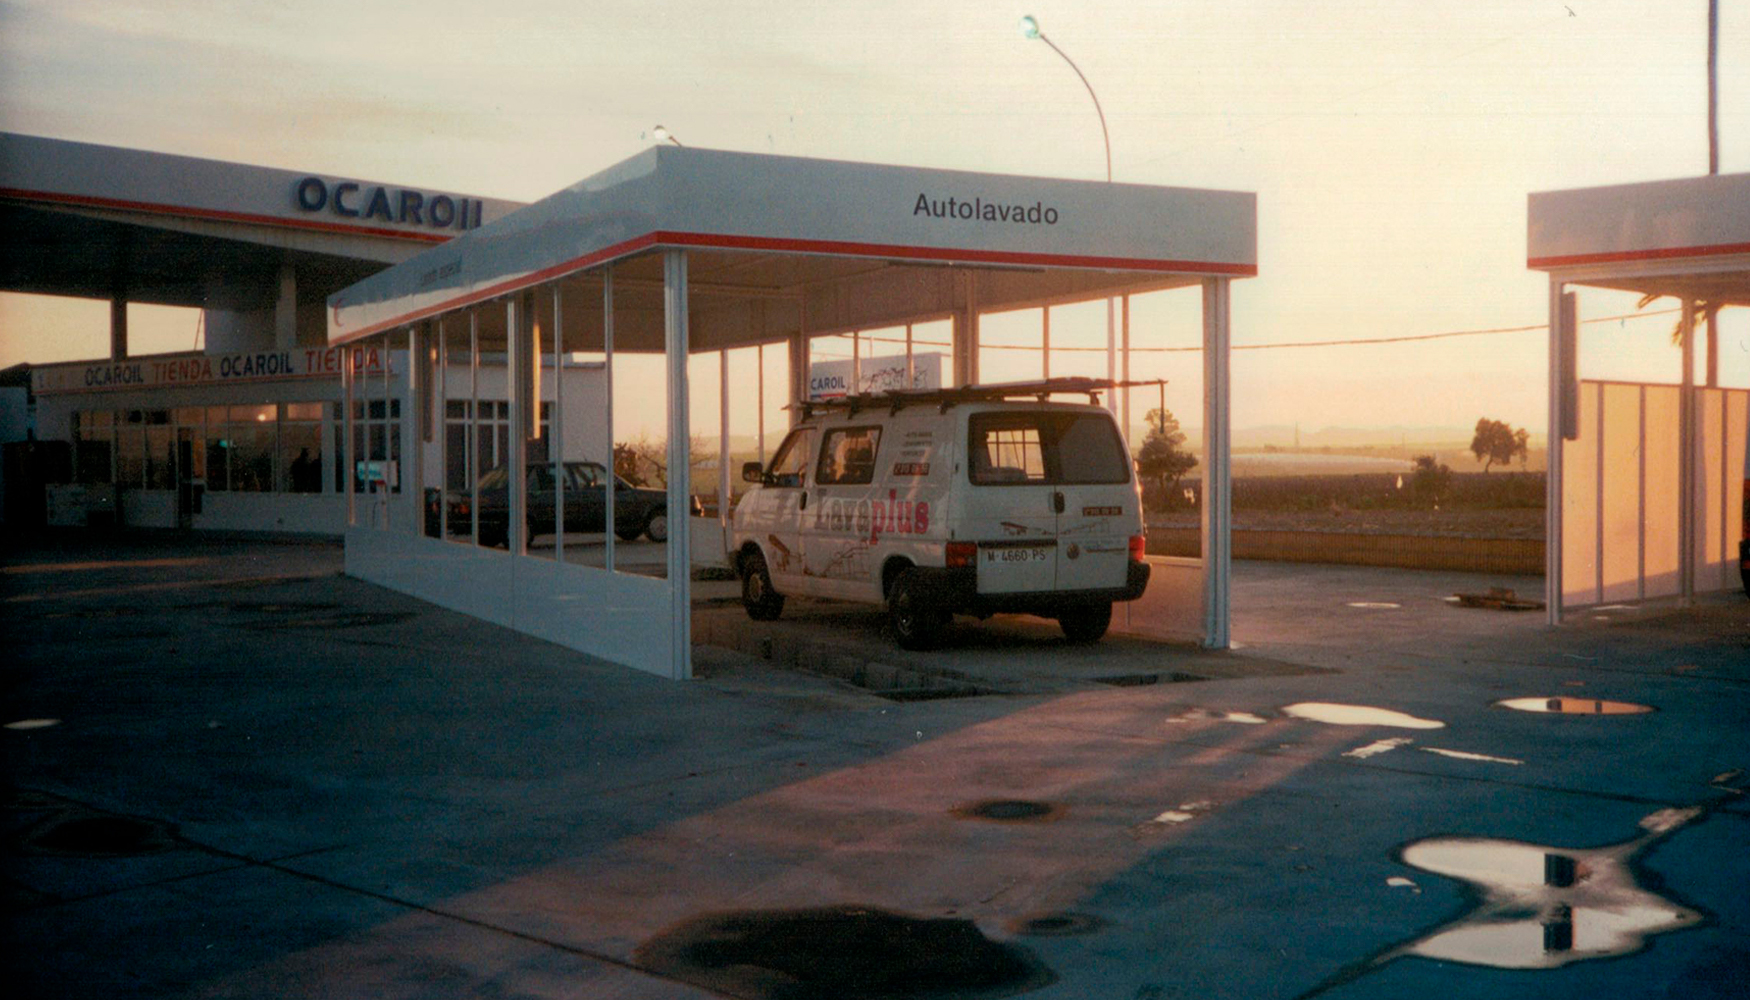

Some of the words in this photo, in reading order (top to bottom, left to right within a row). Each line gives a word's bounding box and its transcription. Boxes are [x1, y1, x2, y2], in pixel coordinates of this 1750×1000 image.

[913, 193, 1059, 225] Autolavado
[84, 364, 144, 387] OCAROIL
[153, 358, 213, 381] TIENDA
[220, 352, 294, 377] OCAROIL
